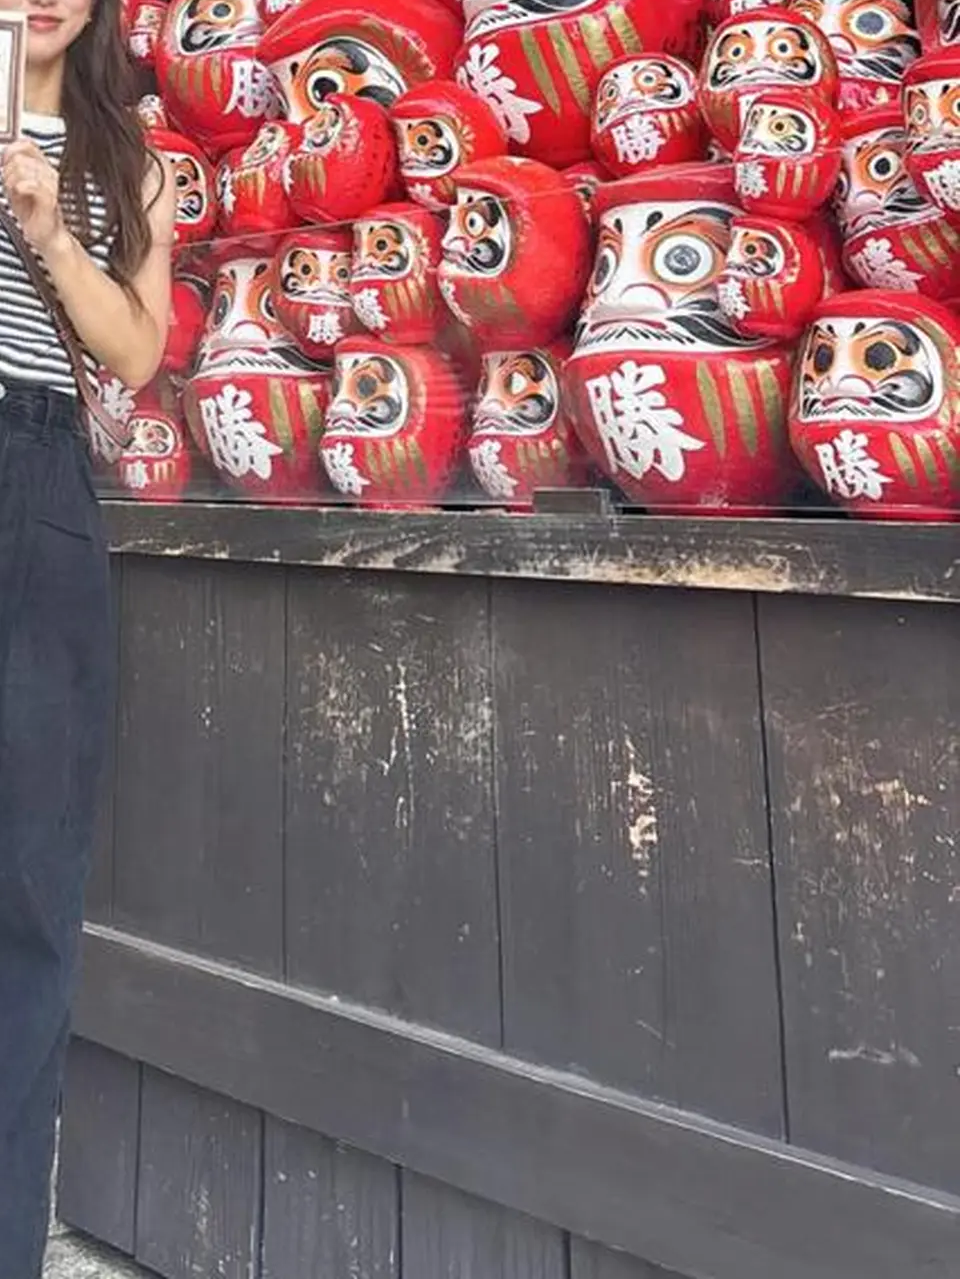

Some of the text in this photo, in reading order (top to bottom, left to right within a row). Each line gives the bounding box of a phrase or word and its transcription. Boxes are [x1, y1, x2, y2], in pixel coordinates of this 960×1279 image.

[610, 113, 667, 164] 勝
[200, 383, 283, 480] 勝
[586, 360, 706, 482] 勝
[815, 429, 894, 501] 勝
